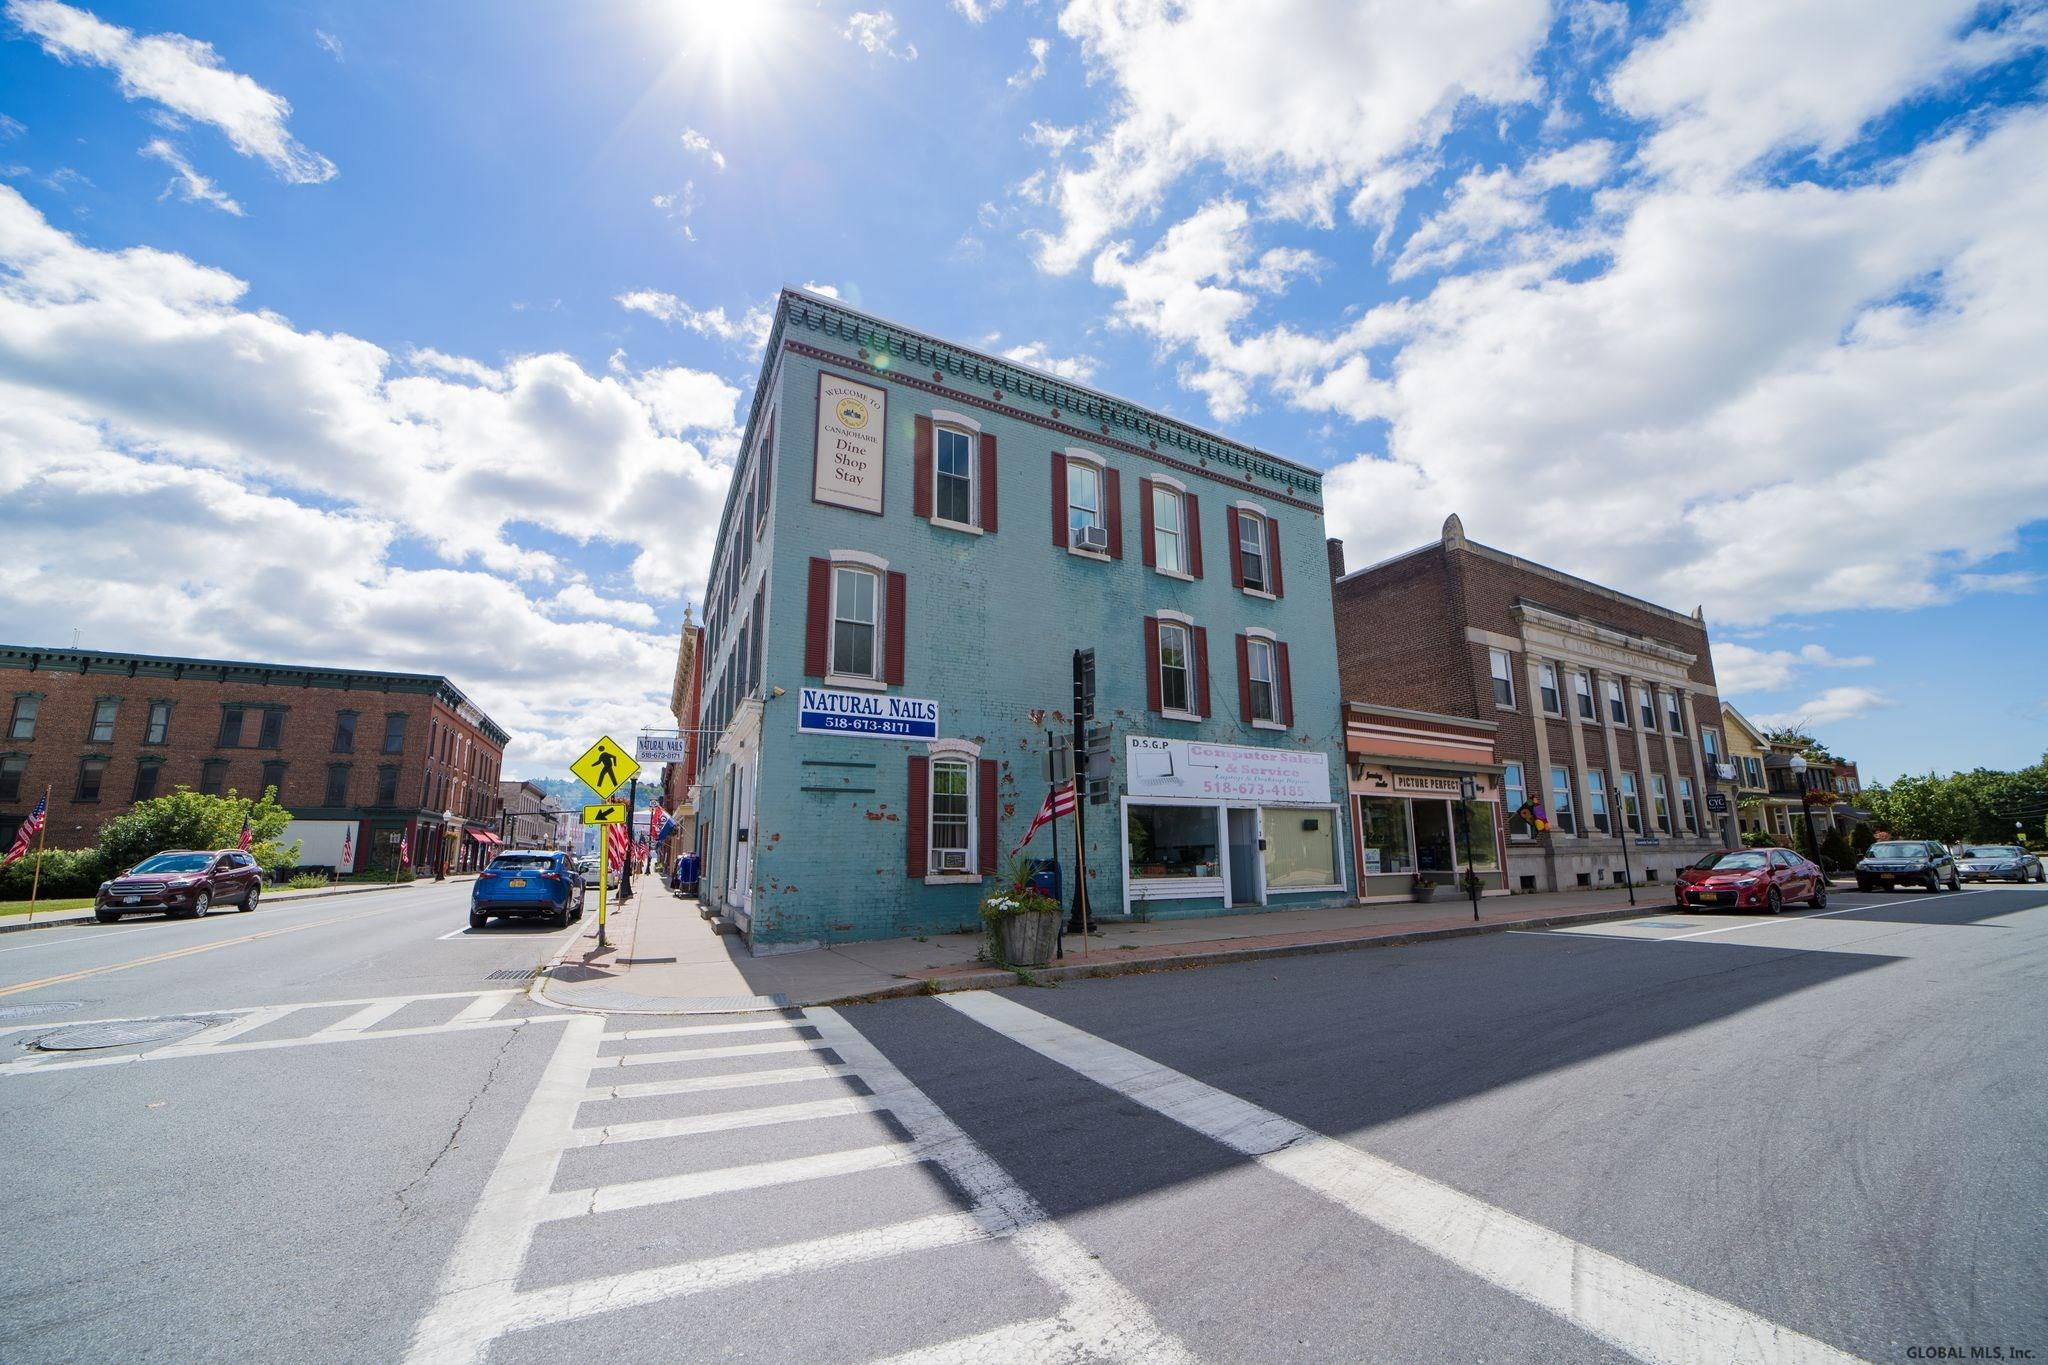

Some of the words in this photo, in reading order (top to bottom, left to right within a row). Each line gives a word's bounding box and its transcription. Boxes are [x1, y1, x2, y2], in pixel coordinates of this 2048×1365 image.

[825, 388, 867, 401] WELCOME
[870, 399, 881, 410] TO
[824, 425, 878, 444] CANAJOHARIE
[836, 438, 867, 456] Dine
[834, 453, 867, 470] Shop
[835, 468, 865, 487] Stay
[803, 690, 883, 716] NATURAL
[889, 698, 936, 720] NAILS
[825, 717, 910, 733] 518-673-8171
[639, 740, 665, 751] NATURAL
[667, 741, 683, 752] NAILS
[1191, 746, 1278, 762] Computer
[1280, 752, 1320, 765] Sales
[1215, 773, 1243, 782] Laptop
[1225, 763, 1238, 773] &
[1241, 764, 1300, 777] Service
[1203, 780, 1305, 797] 518-673-4185
[1398, 776, 1429, 788] PICTURE
[1430, 778, 1460, 790] PERFECT
[1708, 798, 1725, 806] CYC
